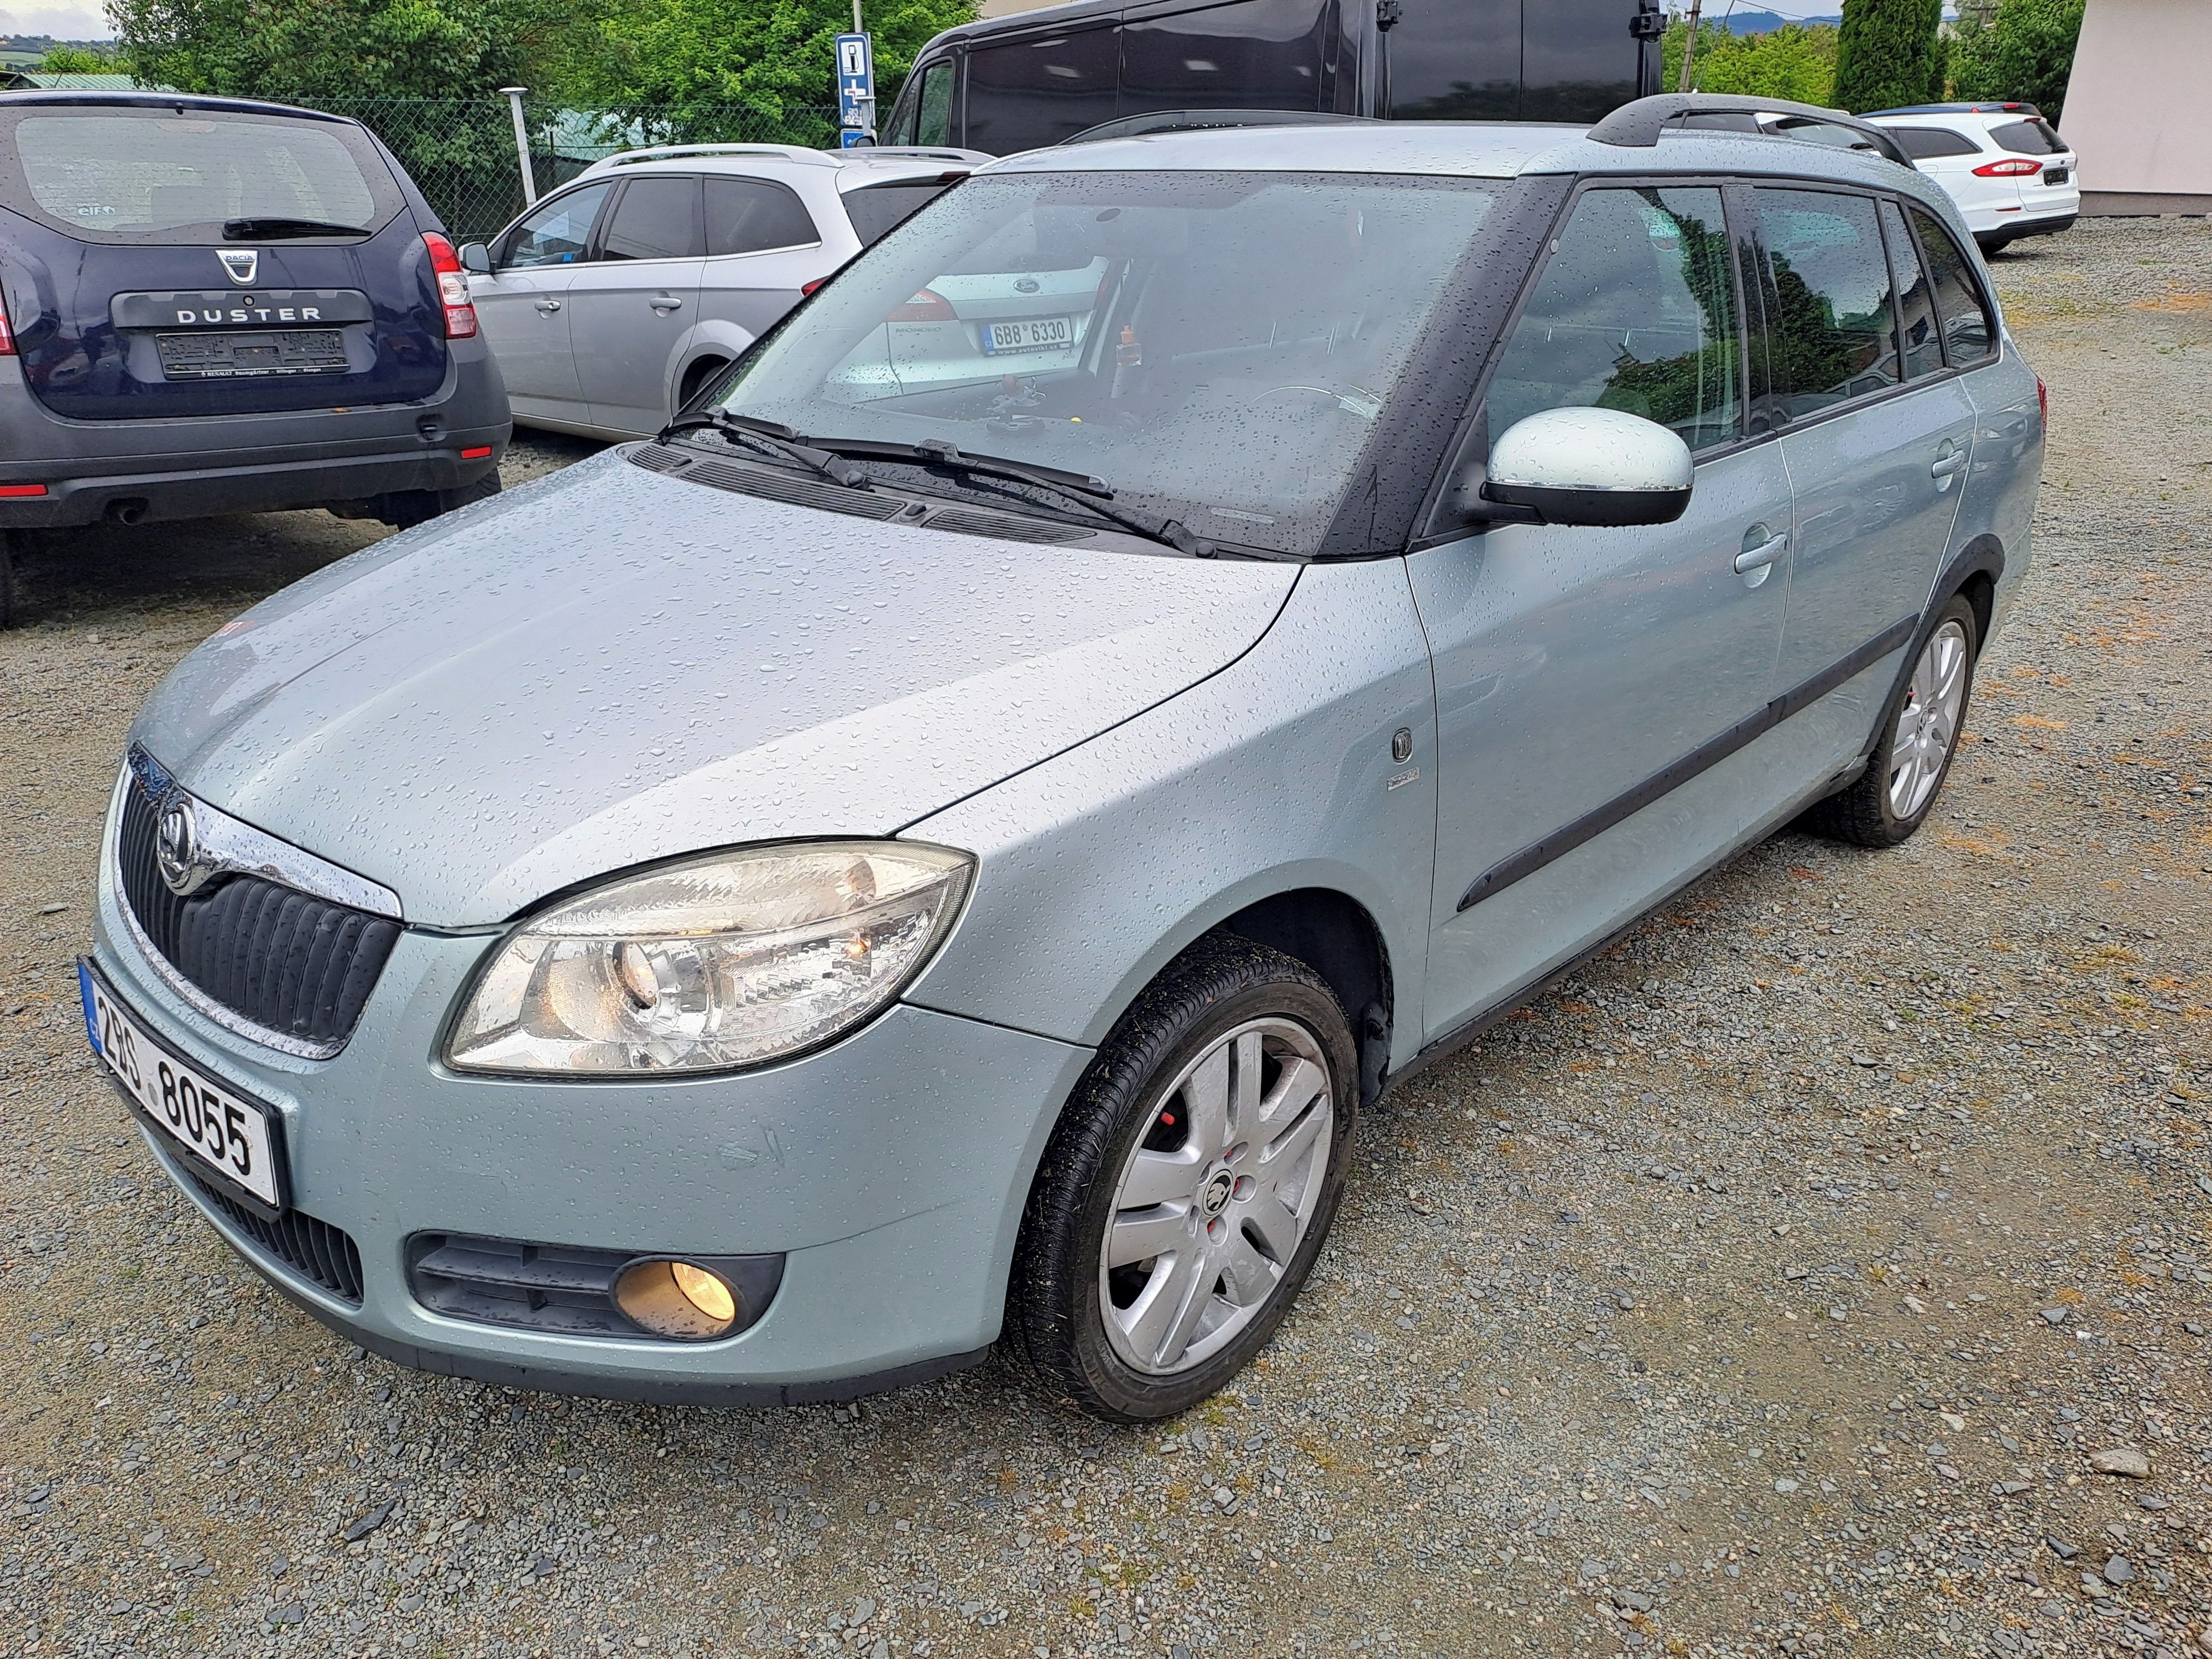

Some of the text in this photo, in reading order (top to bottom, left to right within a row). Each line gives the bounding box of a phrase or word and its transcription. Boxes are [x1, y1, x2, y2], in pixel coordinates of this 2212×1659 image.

[78, 207, 102, 216] elf
[176, 307, 321, 324] DUSTER
[995, 321, 1065, 346] 6B8 6330
[89, 1017, 101, 1041] CZ
[98, 996, 252, 1176] 2BS 8055
